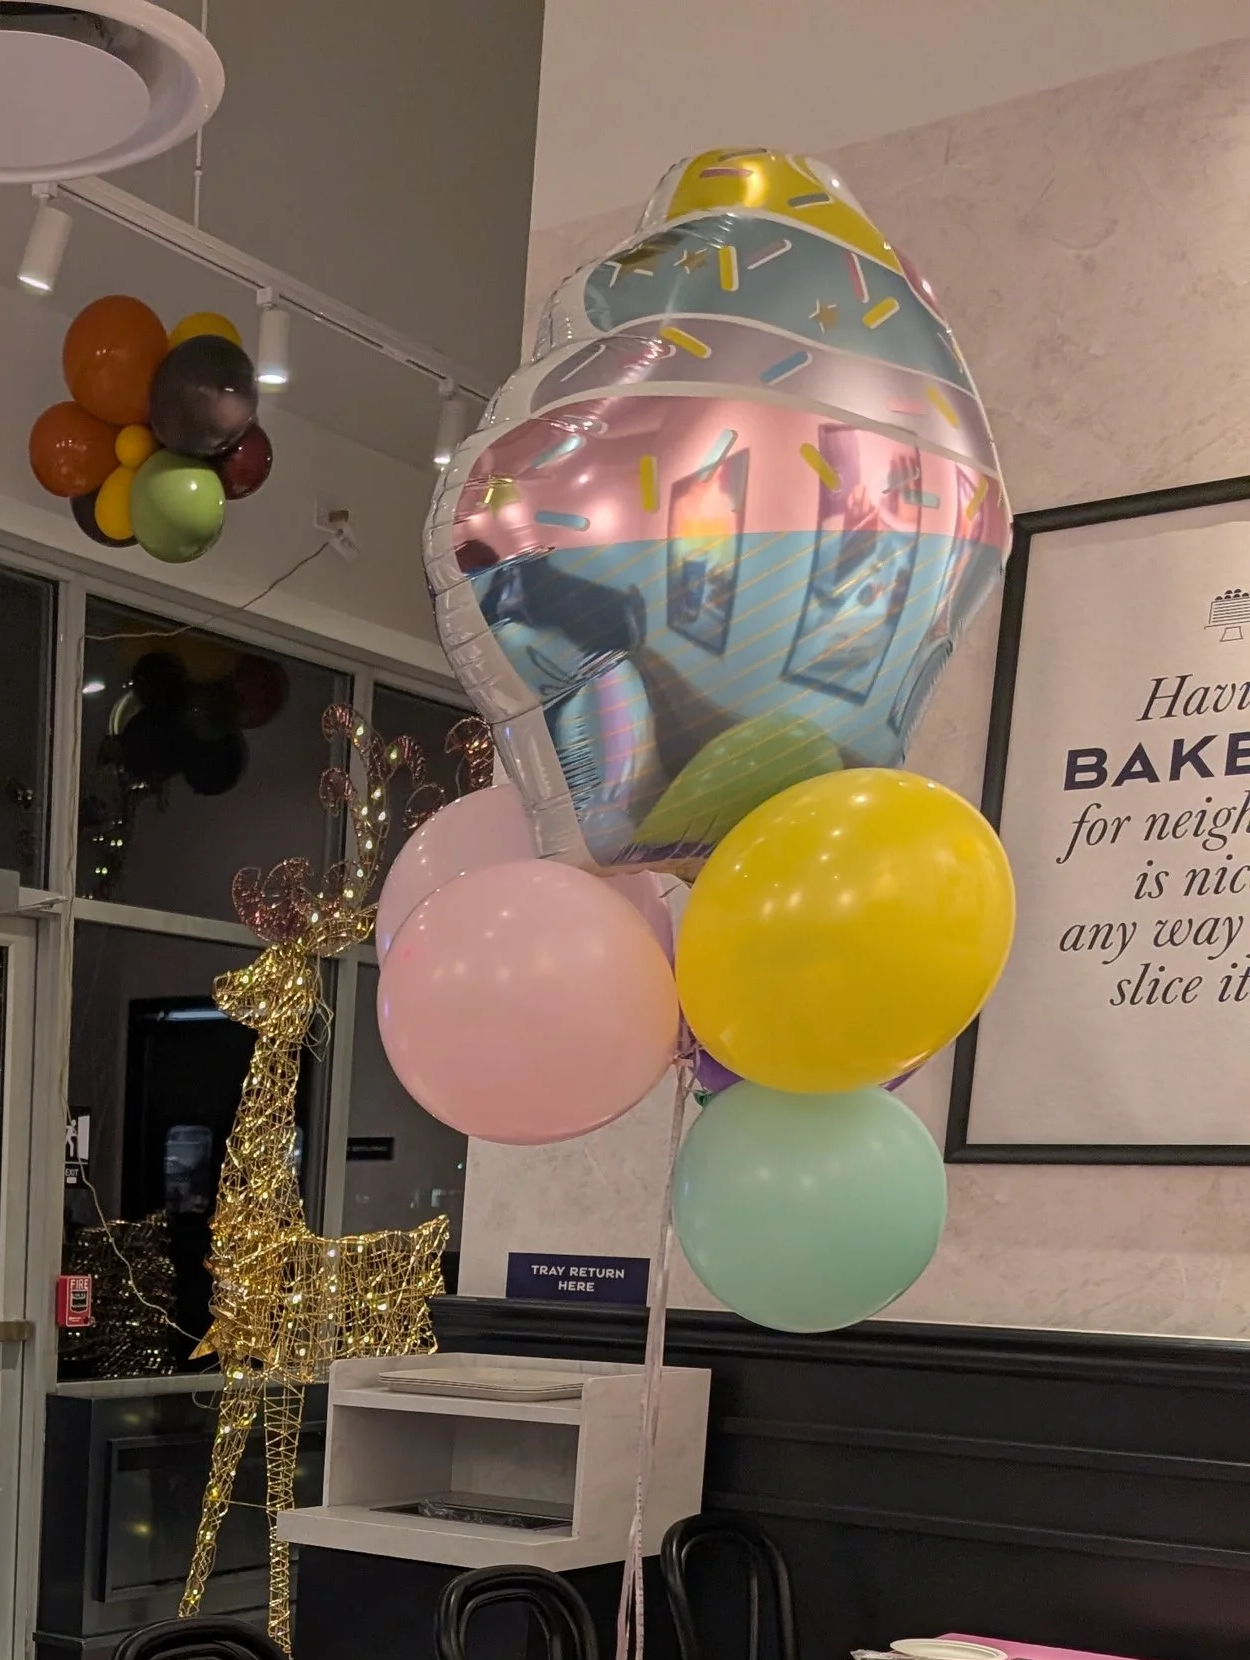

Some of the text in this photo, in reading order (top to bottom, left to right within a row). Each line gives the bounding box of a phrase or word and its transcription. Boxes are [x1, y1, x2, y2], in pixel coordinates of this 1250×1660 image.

[1056, 802, 1131, 864] for
[1134, 854, 1250, 900] is nic
[1059, 915, 1245, 965] any way
[1109, 962, 1203, 1007] slice
[70, 1278, 89, 1290] FIRE
[531, 1264, 625, 1279] TRAY RETURN
[558, 1280, 595, 1292] HERE
